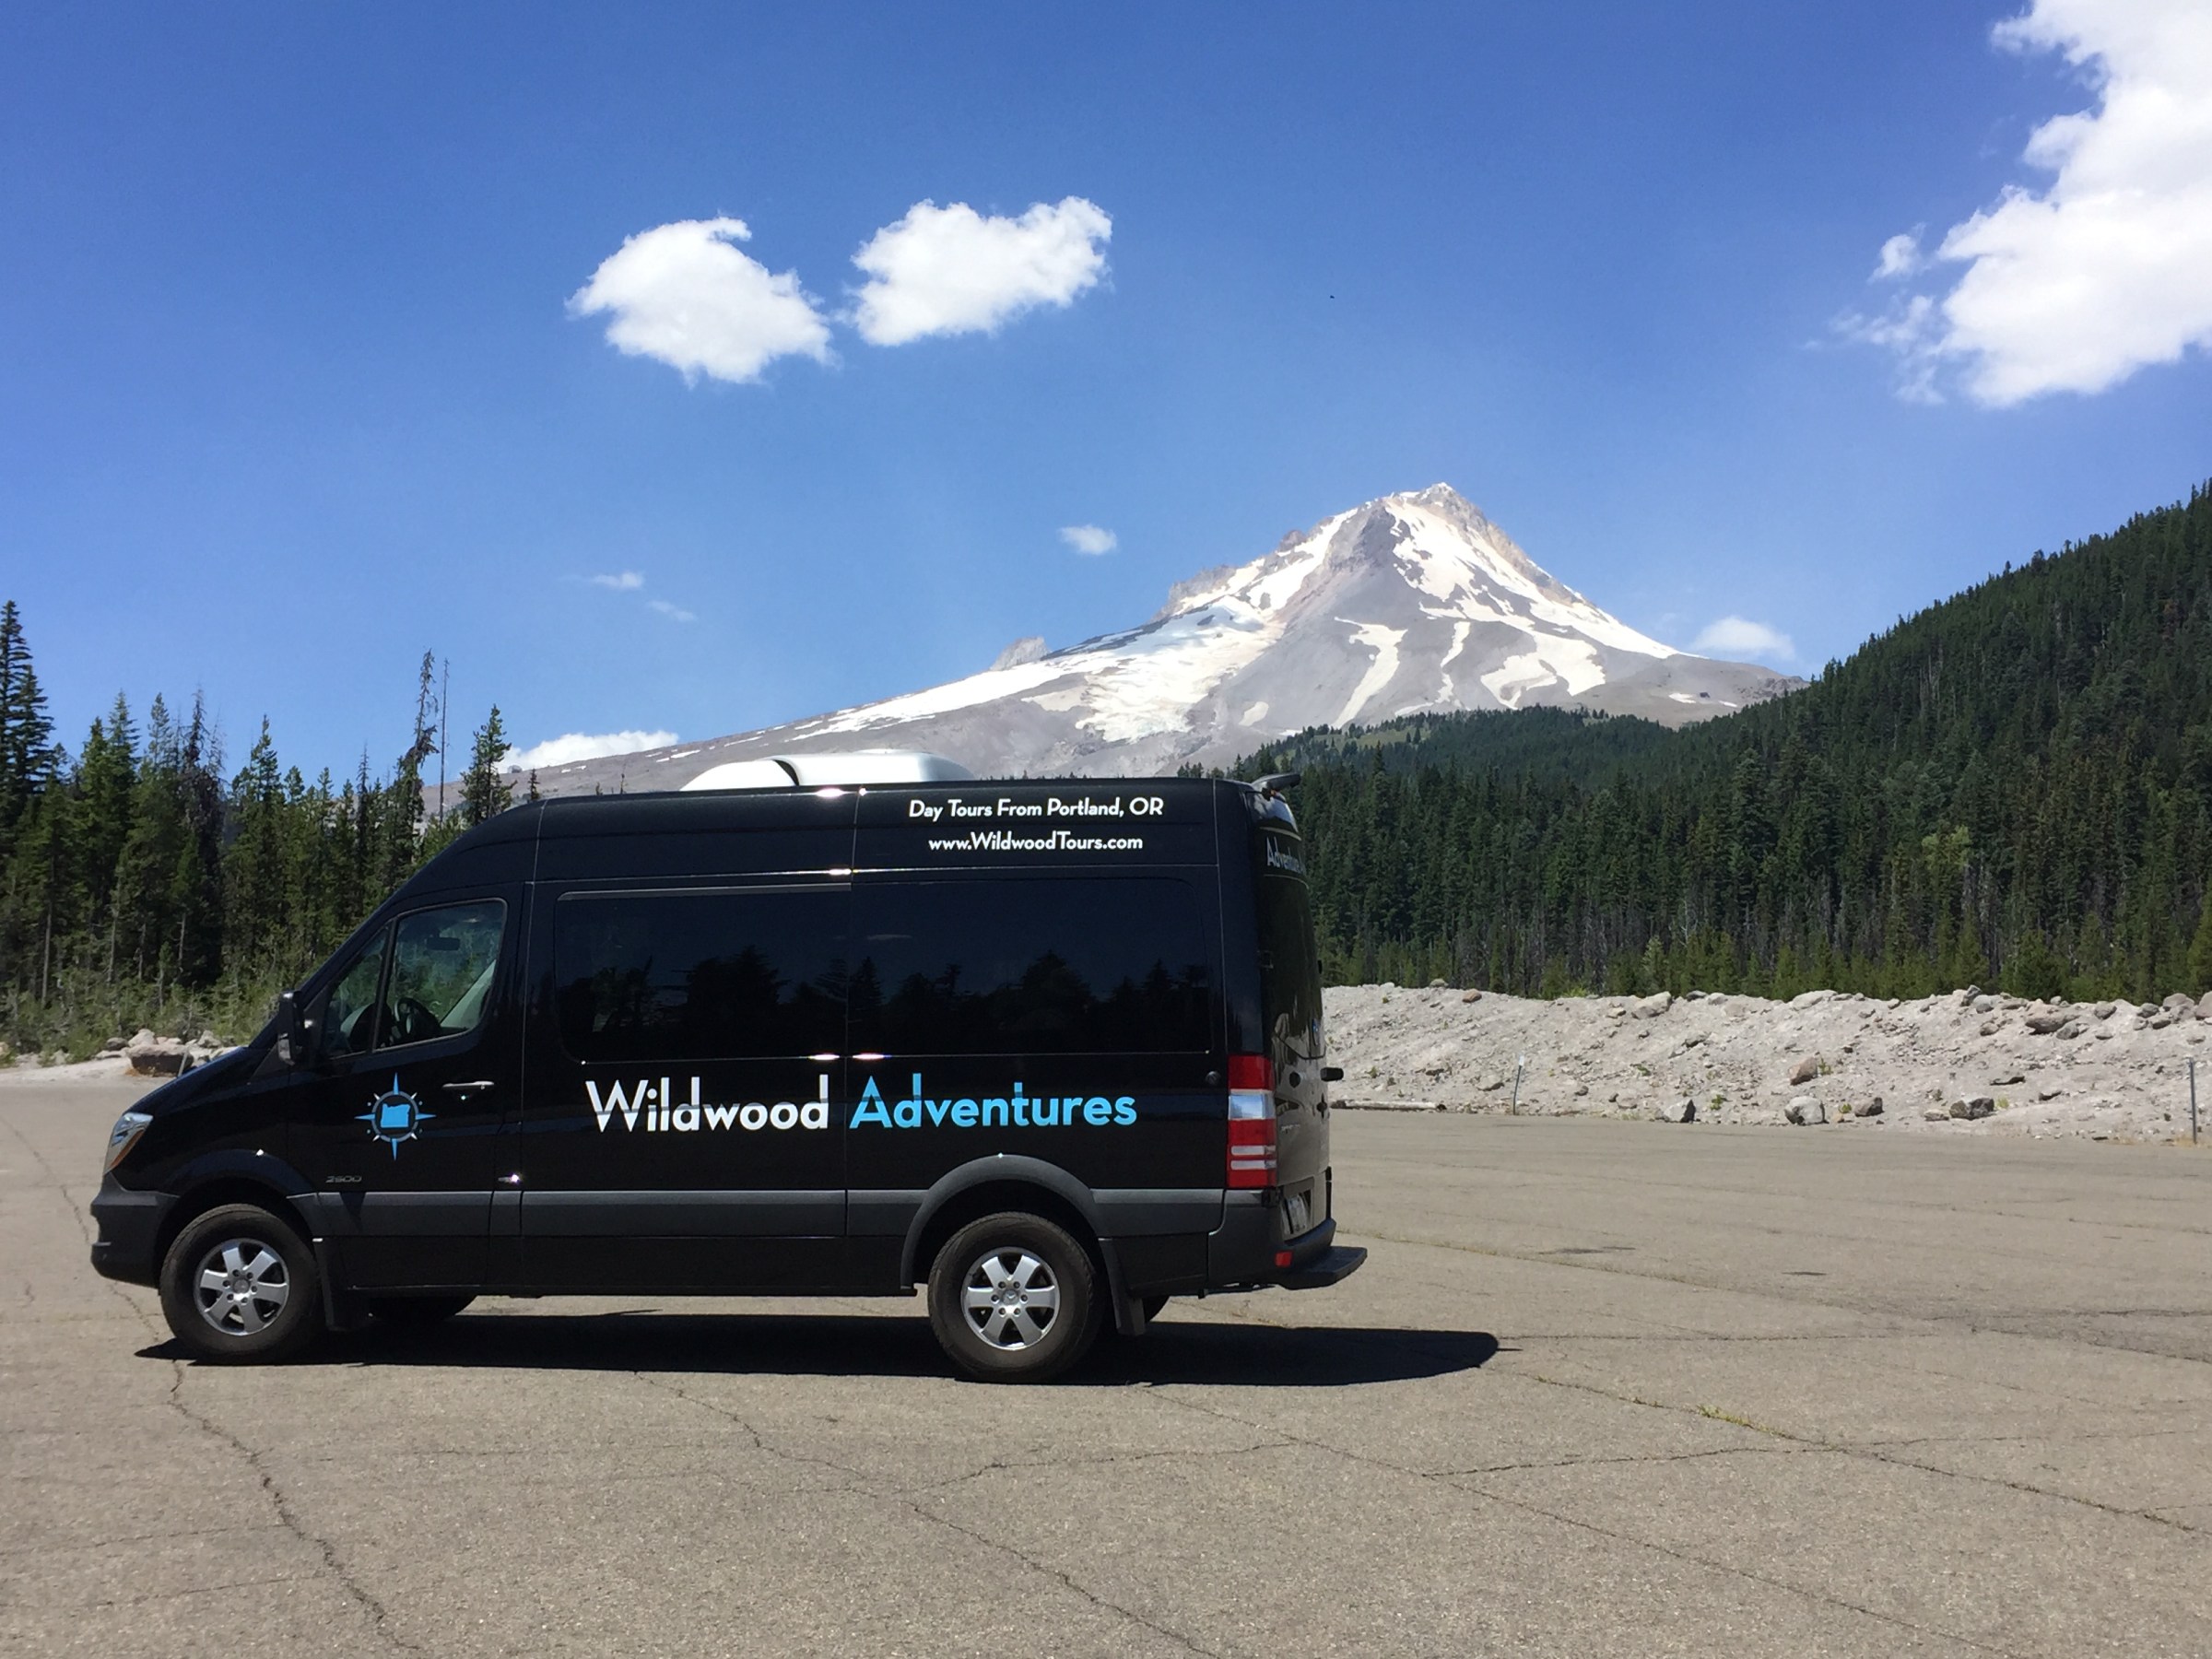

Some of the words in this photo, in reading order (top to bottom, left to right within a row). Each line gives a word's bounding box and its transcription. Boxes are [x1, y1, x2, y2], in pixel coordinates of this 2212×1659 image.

[910, 799, 944, 822] Day
[947, 798, 993, 818] Tours
[997, 797, 1042, 817] From
[1047, 796, 1124, 818] Portland,
[1129, 796, 1164, 816] OR
[928, 830, 1144, 851] www.WildwoodTours.com
[585, 1074, 829, 1133] Wildwood
[849, 1073, 1137, 1129] Adventures
